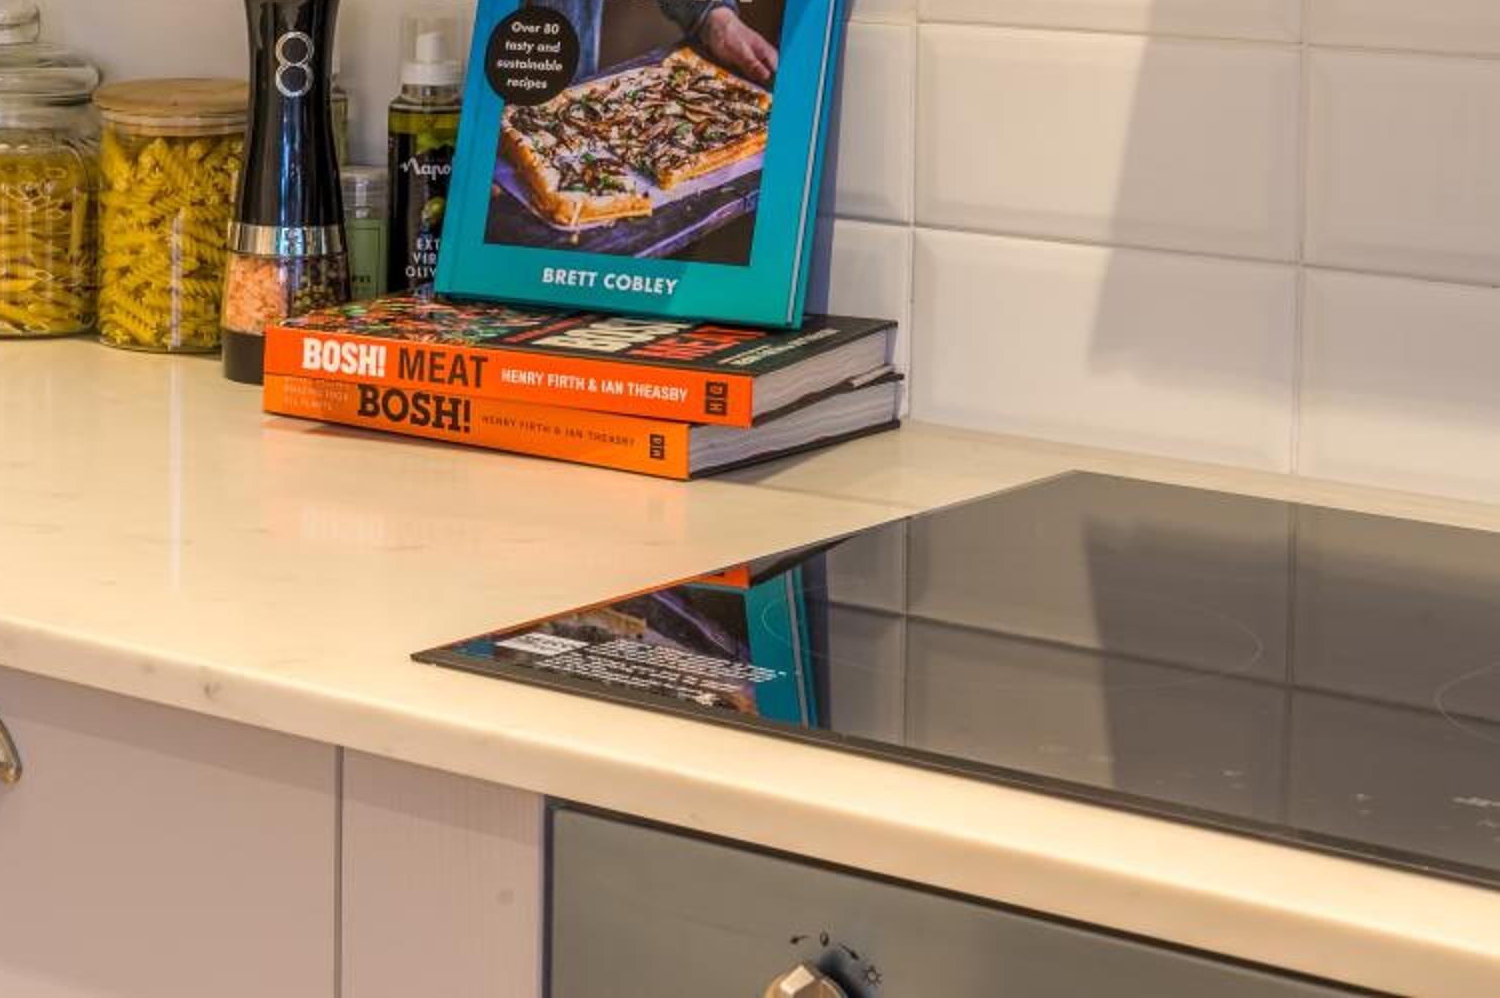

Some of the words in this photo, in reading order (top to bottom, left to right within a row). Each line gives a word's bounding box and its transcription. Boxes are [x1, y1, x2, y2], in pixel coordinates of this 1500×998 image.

[511, 21, 541, 34] Over
[505, 40, 534, 54] tasty
[537, 41, 561, 53] and
[496, 58, 563, 72] sustainable
[507, 76, 547, 90] recipes
[401, 157, 451, 180] Napo
[416, 237, 440, 251] EXT
[412, 252, 437, 265] VIR
[405, 265, 437, 278] OLIV
[543, 267, 598, 289] BRETT
[603, 273, 679, 296] COBLEY
[302, 337, 387, 378] BOSH!
[397, 346, 488, 389] MEAT
[501, 368, 545, 387] HENRY
[547, 375, 585, 392] FIRTH
[588, 378, 597, 392] &
[601, 379, 624, 395] IAN
[627, 382, 689, 402] THEASBY
[357, 383, 472, 434] BOSH!
[481, 415, 516, 428] HENRY
[519, 420, 550, 435] FIRTH
